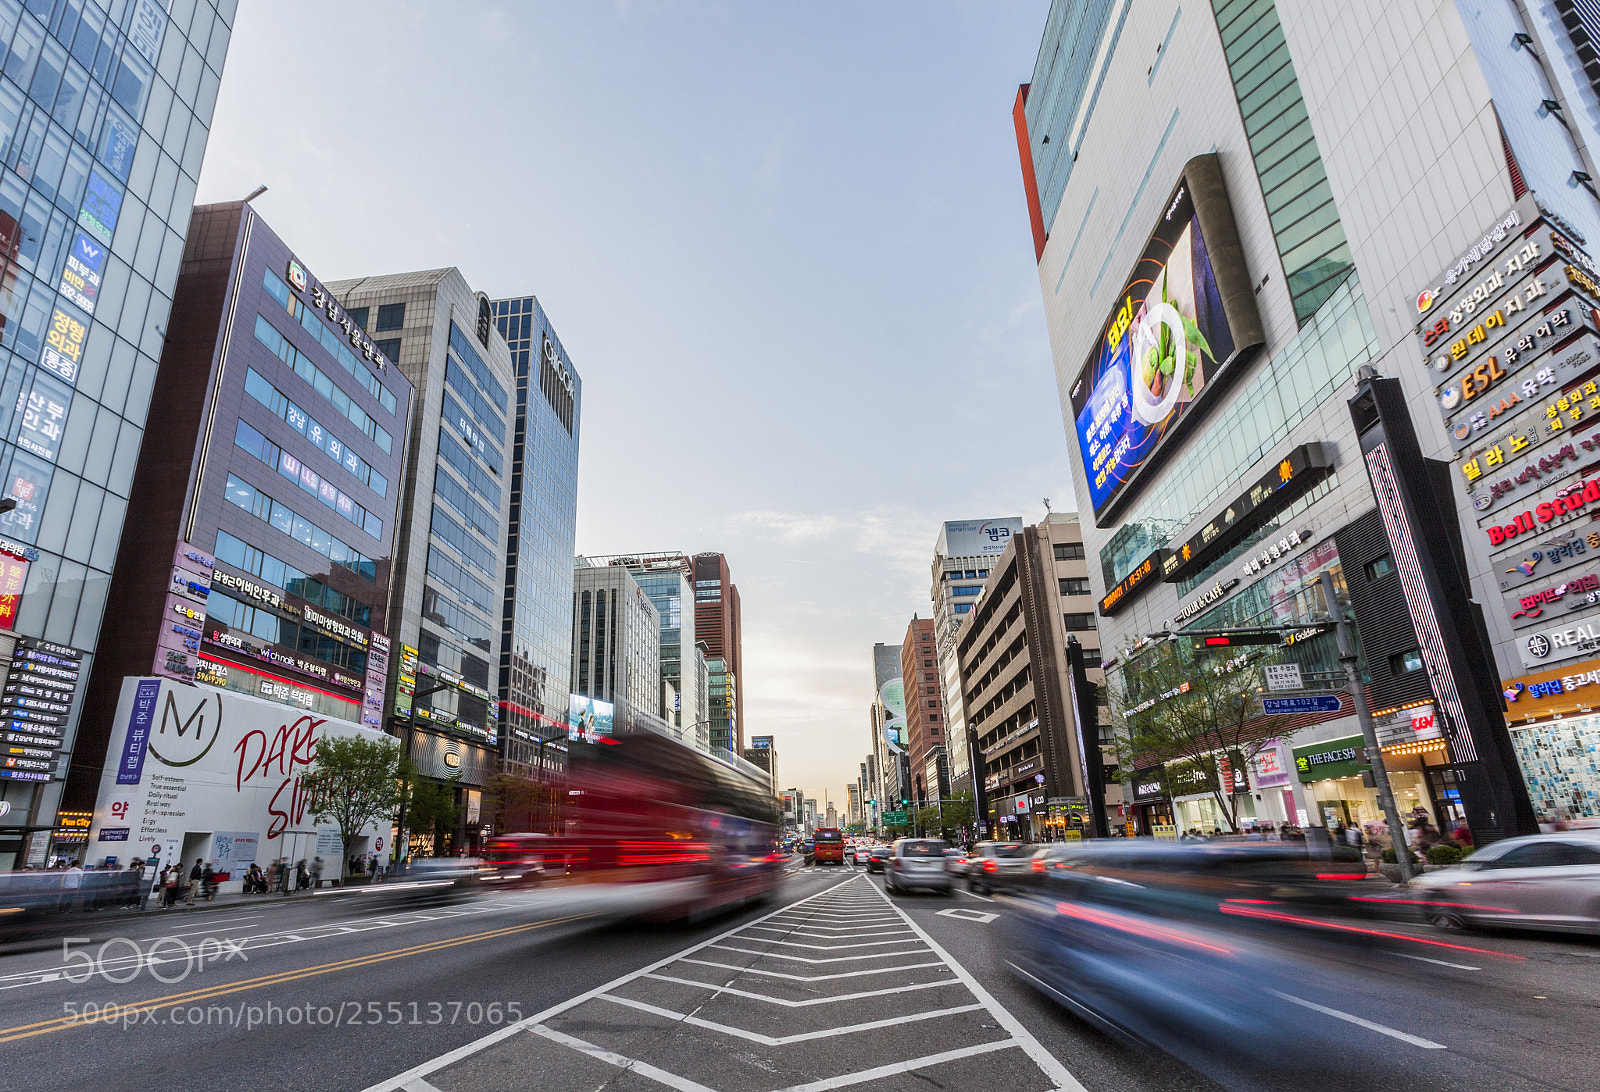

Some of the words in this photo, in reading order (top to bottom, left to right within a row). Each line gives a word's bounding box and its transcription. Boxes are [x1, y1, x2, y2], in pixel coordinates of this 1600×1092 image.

[1444, 210, 1522, 285] 유가네닭갈비
[63, 269, 85, 291] 비만
[67, 255, 100, 287] 피부과
[1423, 317, 1450, 347] 스타
[1449, 270, 1506, 325] 성형외과
[1505, 241, 1541, 276] 치과
[54, 310, 85, 344] 정형
[1451, 310, 1507, 361] 원데이
[1504, 279, 1547, 316] 치과
[47, 329, 81, 362] 외과
[46, 350, 74, 377] 통증
[1461, 356, 1507, 400] ESL
[25, 390, 64, 420] 산부
[1489, 392, 1522, 420] AAA
[1521, 366, 1557, 398] 유학
[22, 412, 60, 440] 인과
[288, 406, 306, 429] 강남
[1550, 394, 1600, 431] 피부과
[1462, 434, 1530, 481] 밀라노
[1546, 380, 1598, 418] 성형외과
[1486, 511, 1535, 546] Bell
[1536, 477, 1600, 523] Stud
[984, 526, 1010, 542] 캠코
[1261, 530, 1302, 564] 성형외과
[1546, 537, 1587, 565] 알라딘
[213, 569, 280, 608] 김성근이비인후과
[1567, 574, 1600, 594] 의원
[1295, 627, 1318, 643] Golden
[1551, 624, 1600, 649] REAL
[273, 683, 290, 700] 박준
[1528, 679, 1563, 698] 알라딘
[1562, 669, 1600, 691] 중고서
[136, 699, 151, 725] 박준
[1265, 698, 1318, 708] 강남대로102길
[1411, 715, 1434, 731] CGV
[127, 728, 144, 769] 뷰티랩
[234, 715, 328, 793] DARE
[1308, 754, 1323, 766] THE
[1323, 750, 1343, 764] FACE
[152, 774, 185, 783] Self-esteem
[148, 791, 163, 800] Daily
[61, 818, 76, 827] Fun
[76, 818, 91, 828] City
[111, 801, 129, 820] 약
[142, 817, 156, 826] Edgy
[144, 808, 186, 817] Self-expression
[139, 835, 156, 843] Lively
[140, 826, 168, 834] Effortless
